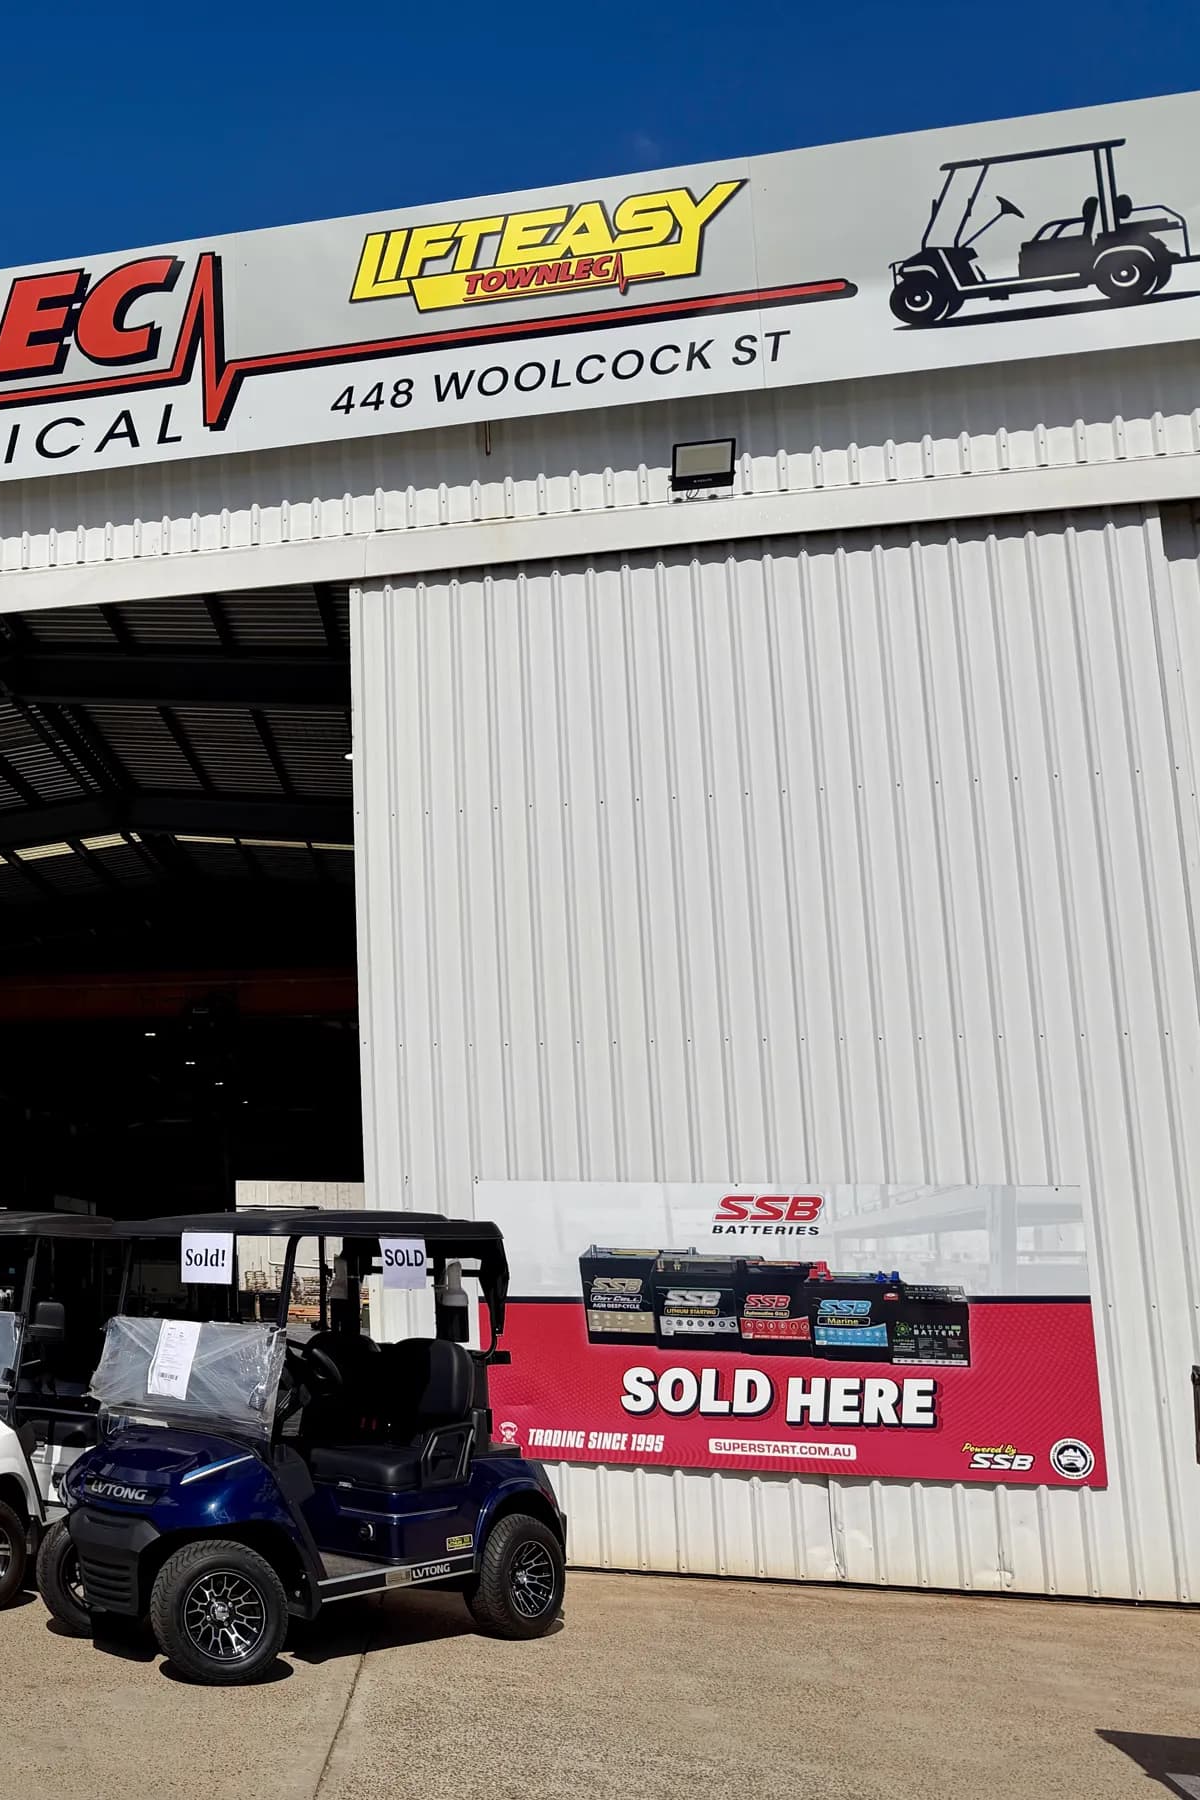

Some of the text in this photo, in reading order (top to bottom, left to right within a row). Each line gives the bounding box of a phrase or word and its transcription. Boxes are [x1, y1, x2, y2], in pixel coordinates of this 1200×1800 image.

[350, 178, 748, 302] LIFTEASY
[464, 256, 618, 294] TOWNLEC
[330, 330, 791, 415] 448 WOOLCOCK ST
[713, 1194, 824, 1222] SSB
[712, 1225, 819, 1235] BATTERIES
[184, 1248, 226, 1267] Sold!
[384, 1248, 424, 1268] SOLD
[591, 1278, 642, 1293] SSB
[664, 1290, 721, 1306] SSB
[744, 1294, 790, 1309] SSB
[817, 1300, 871, 1316] SSB
[827, 1317, 859, 1325] Marine
[620, 1366, 937, 1427] SOLD HERE
[527, 1428, 664, 1452] TRADING SINCE 1995
[714, 1441, 851, 1457] SUPERSTART.COM.AU
[962, 1443, 1017, 1456] Powered By
[969, 1453, 1034, 1470] SSB
[91, 1480, 148, 1500] LVTONG
[412, 1563, 450, 1579] LVTONG
